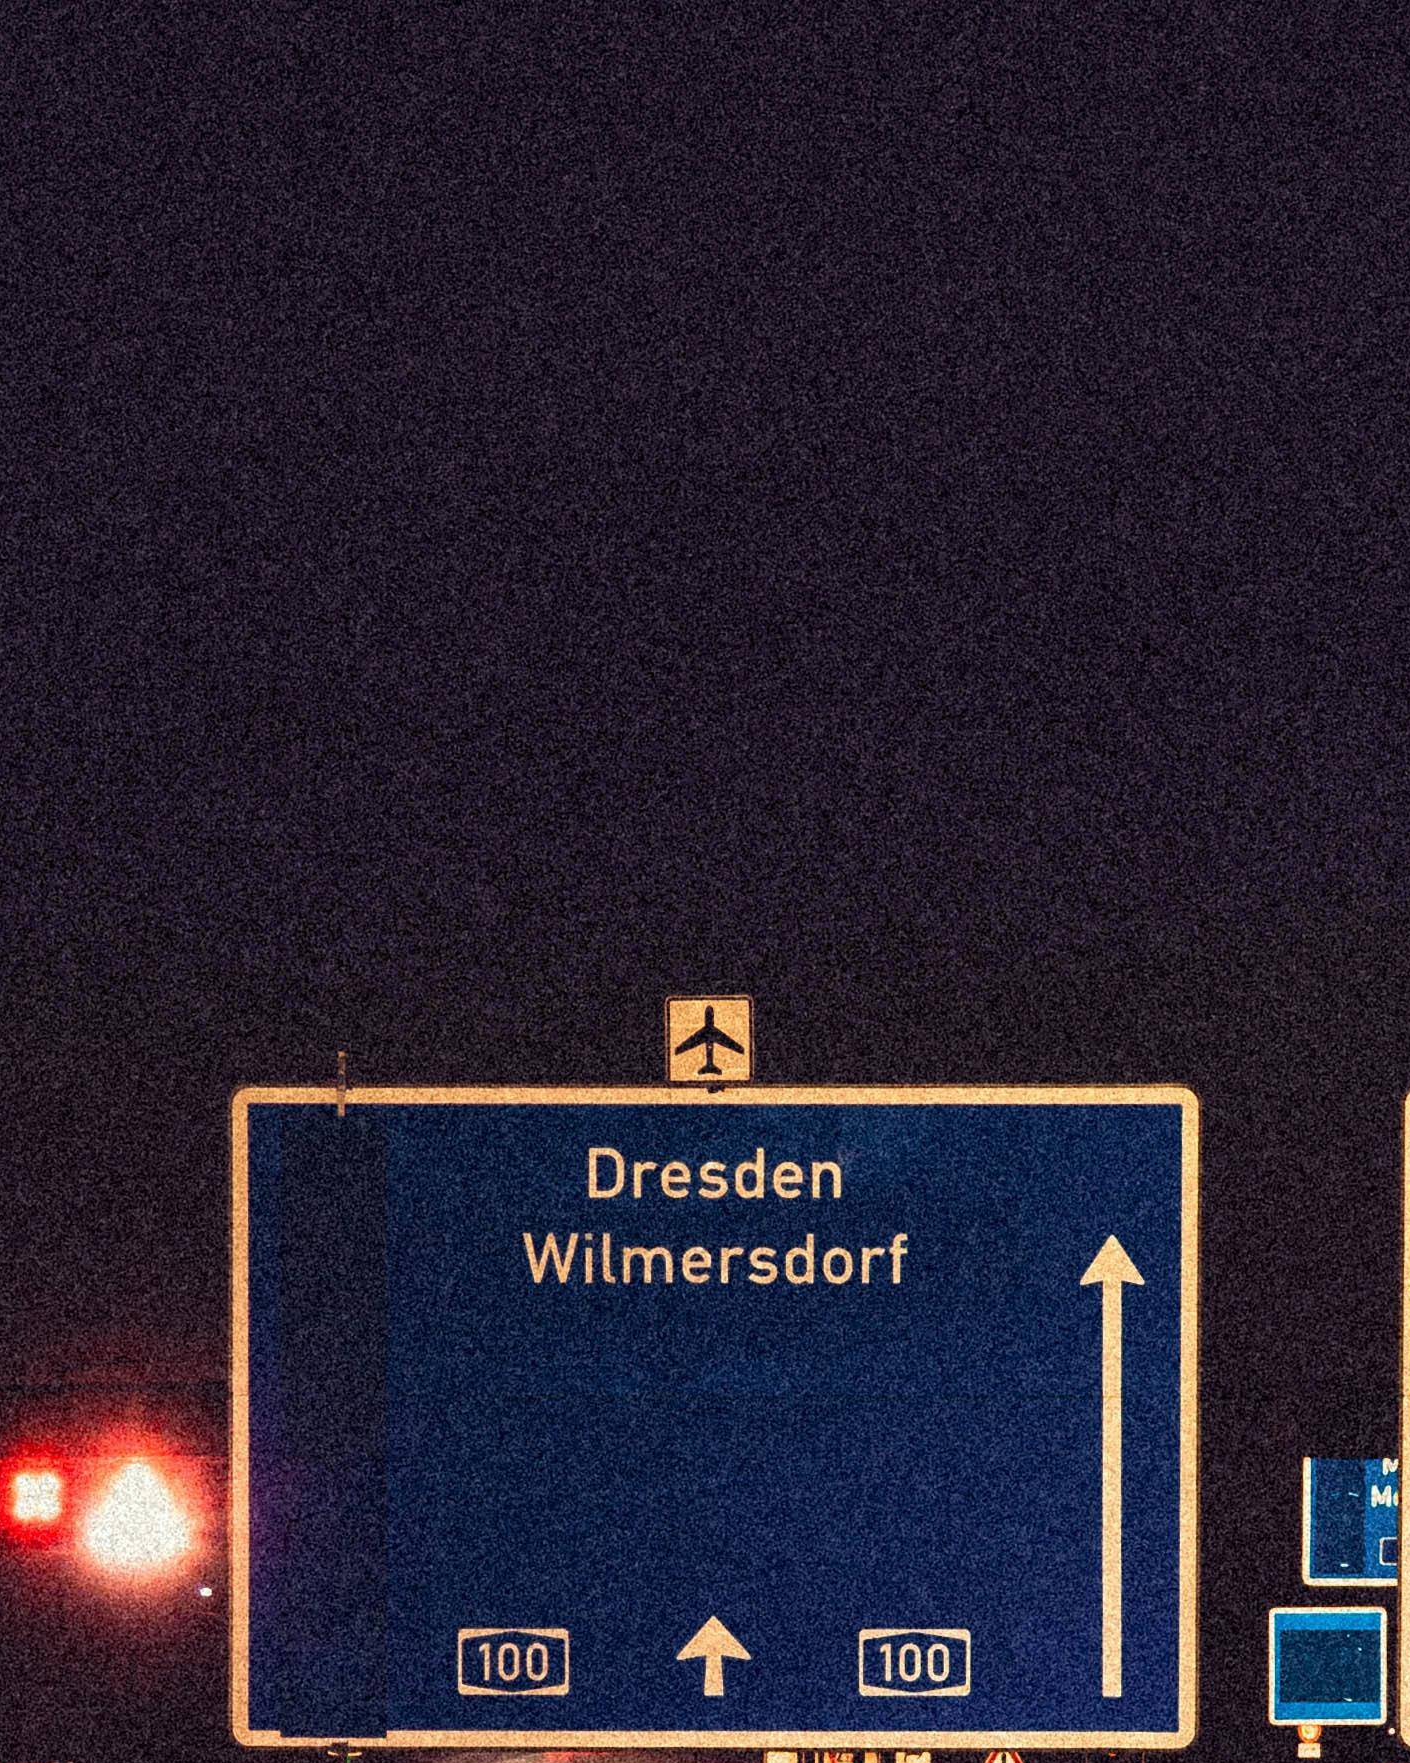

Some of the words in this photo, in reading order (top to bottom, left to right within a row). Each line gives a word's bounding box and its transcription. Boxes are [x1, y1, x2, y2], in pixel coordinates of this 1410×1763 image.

[588, 1147, 842, 1199] Dresden
[523, 1232, 908, 1285] Wilmersdorf
[478, 1642, 549, 1682] 100
[879, 1642, 951, 1682] 100
